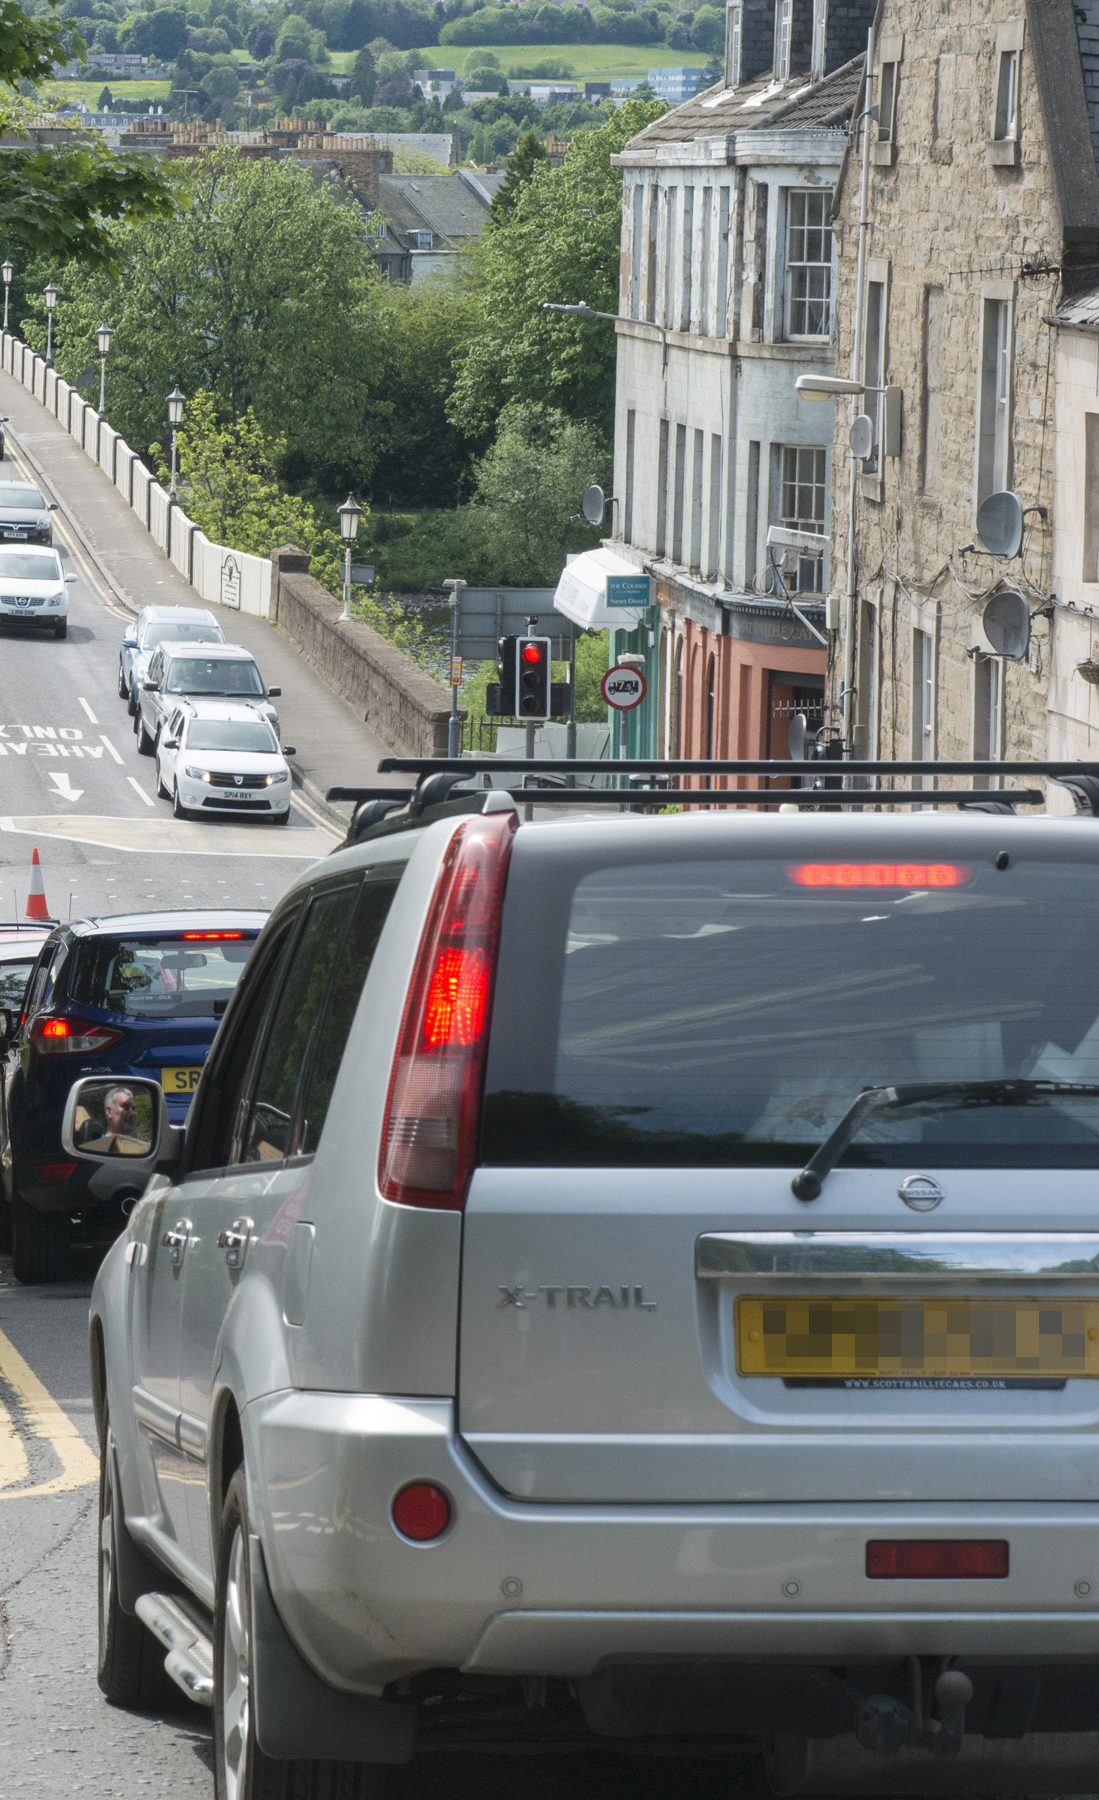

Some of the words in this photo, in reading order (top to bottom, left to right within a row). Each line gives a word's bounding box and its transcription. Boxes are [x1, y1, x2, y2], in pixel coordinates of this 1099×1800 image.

[223, 791, 239, 799] SP14
[496, 1285, 657, 1310] X-TRAIL
[844, 1379, 1006, 1389] WWW.SCOTTBAILLIECARS.CO.UK
